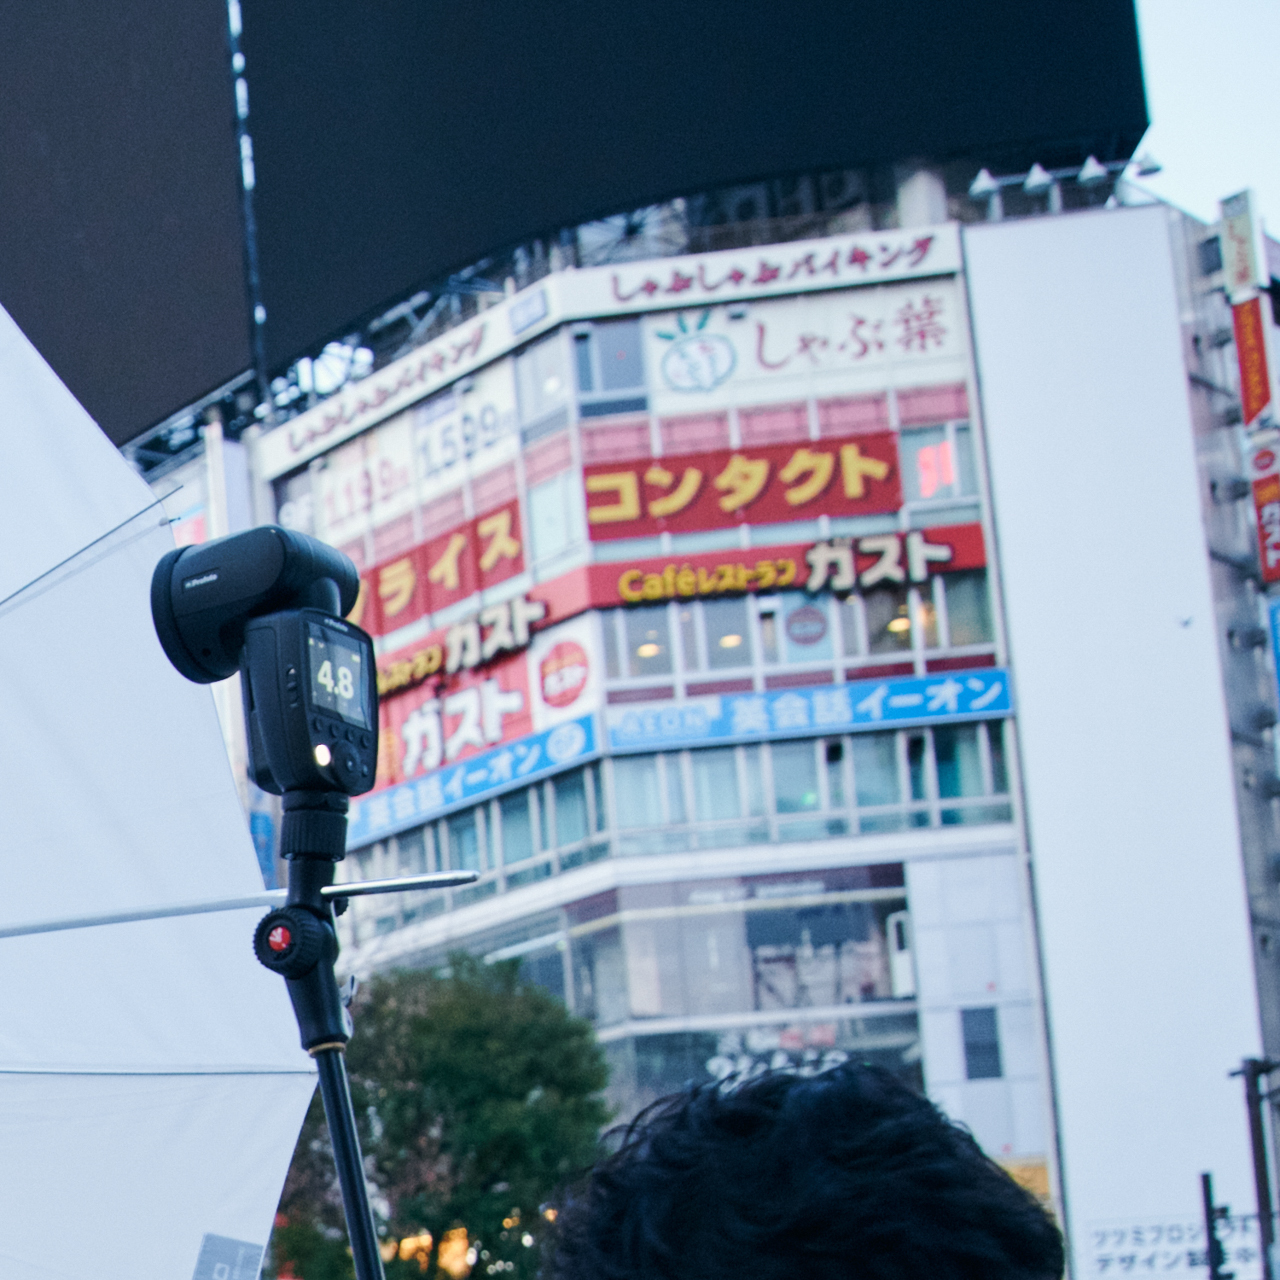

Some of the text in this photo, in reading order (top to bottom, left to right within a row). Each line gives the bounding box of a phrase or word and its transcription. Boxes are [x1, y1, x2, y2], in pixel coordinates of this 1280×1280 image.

[612, 236, 935, 301] しゃぶしゃぶバイキング
[754, 296, 947, 370] しゃぶ葉
[585, 443, 890, 525] コンタクト
[805, 531, 953, 592] ガスト
[445, 595, 545, 675] ガスト
[318, 659, 355, 700] 4.8
[732, 675, 1003, 738] 英会話イーオン
[401, 676, 524, 780] ガスト
